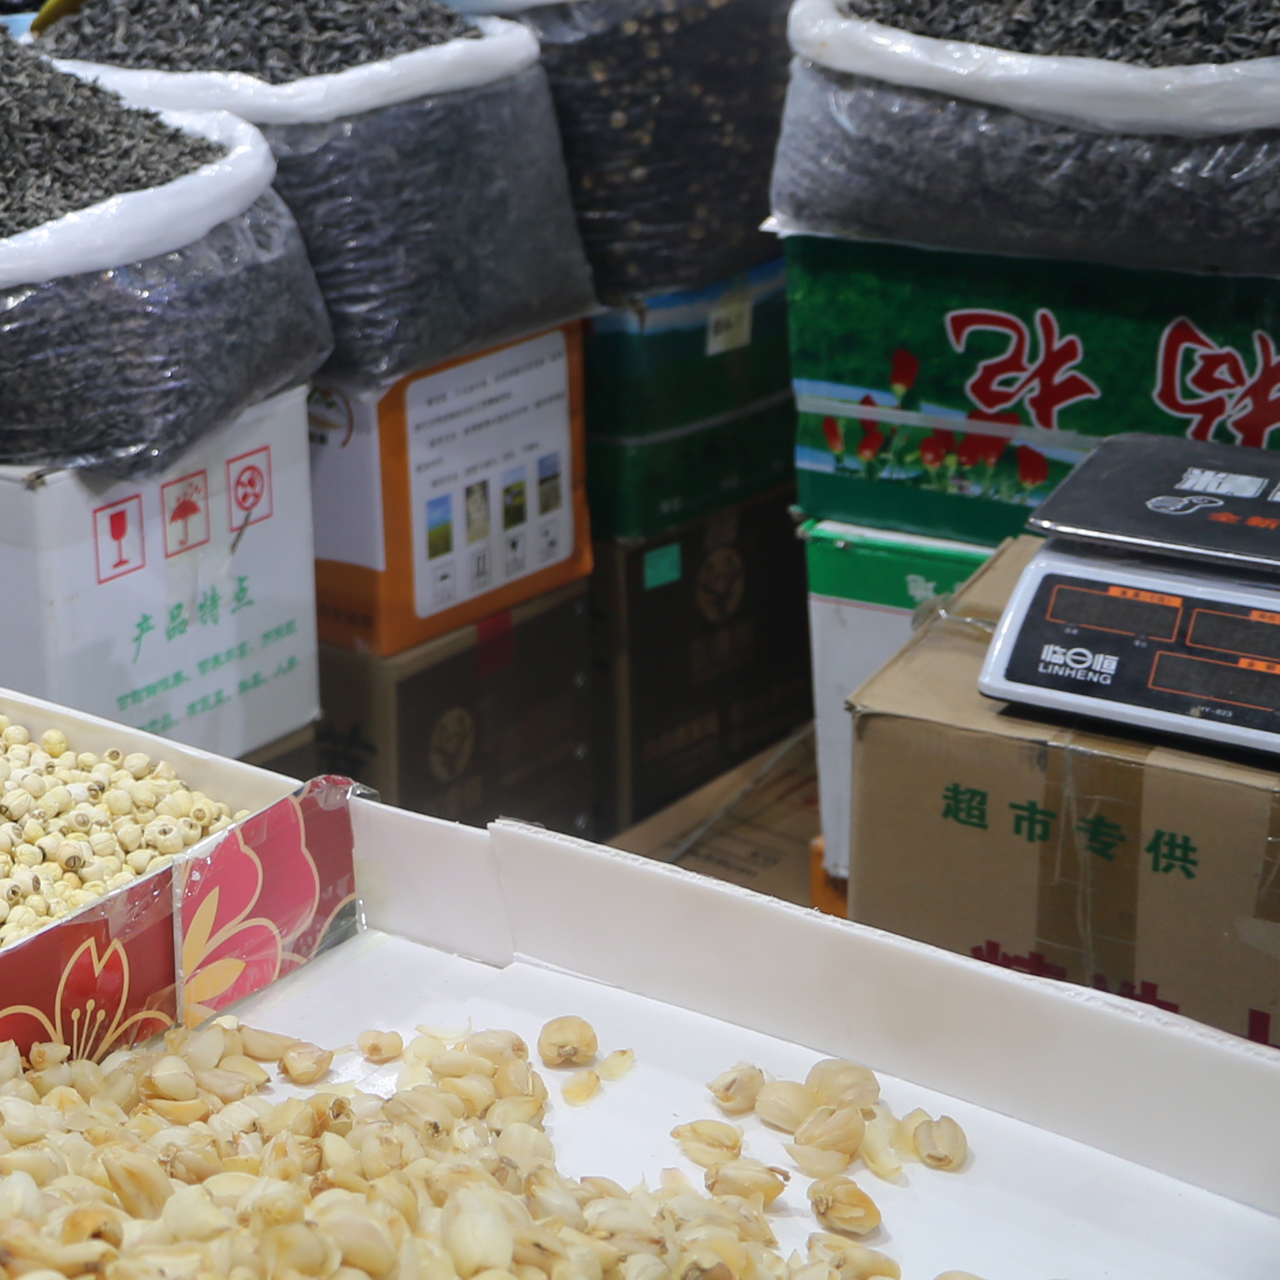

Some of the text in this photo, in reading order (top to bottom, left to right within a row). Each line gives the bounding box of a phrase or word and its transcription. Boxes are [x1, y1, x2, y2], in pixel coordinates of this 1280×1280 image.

[132, 575, 256, 664] 产品特点
[1038, 662, 1112, 686] LINHENG
[941, 782, 1199, 880] 超市专供
